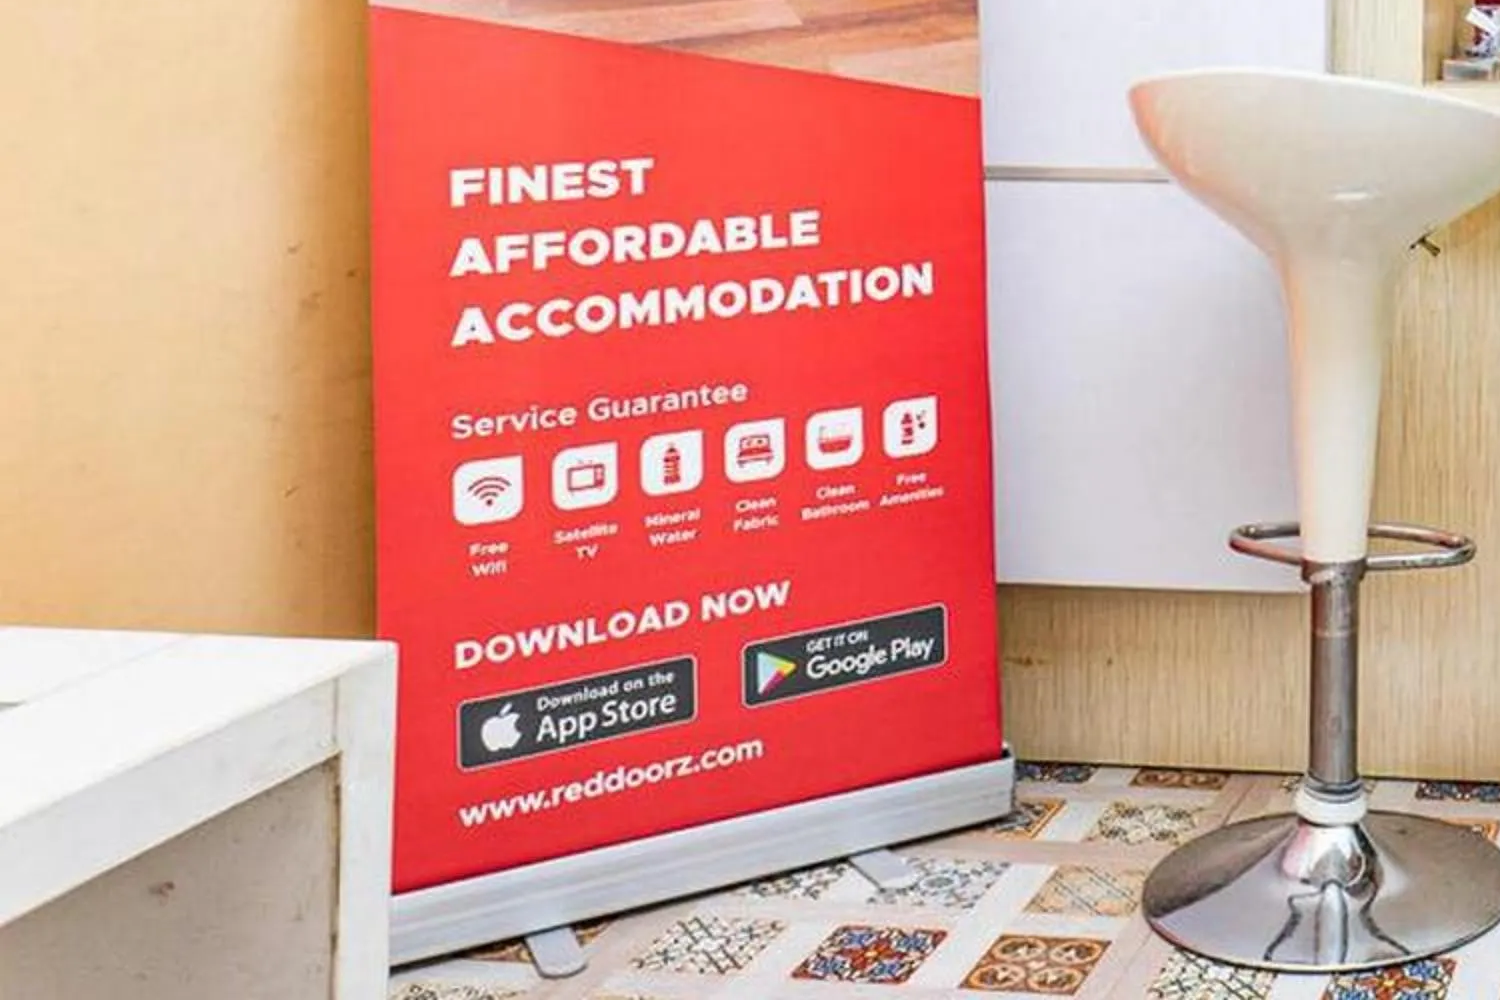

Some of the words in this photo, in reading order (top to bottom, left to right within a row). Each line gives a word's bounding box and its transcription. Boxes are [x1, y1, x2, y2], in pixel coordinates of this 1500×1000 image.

[449, 157, 655, 207] FINEST
[449, 210, 821, 277] AFFORDABLE
[450, 262, 935, 347] ACCOMMODATION
[452, 401, 577, 441] Service
[588, 382, 749, 423] Guarantee
[896, 472, 928, 487] Free
[815, 483, 857, 500] Clean
[879, 485, 945, 507] Amenities
[735, 496, 778, 513] Clean
[800, 499, 871, 521] Bathroom
[644, 507, 702, 528] Mineral
[733, 515, 780, 532] Fabric
[553, 522, 619, 544] Satellite
[648, 528, 698, 547] Water
[468, 541, 509, 557] Free
[575, 543, 600, 559] TV
[454, 600, 691, 670] DOWNLOAD
[700, 580, 792, 622] NOW
[806, 636, 832, 653] GET
[833, 632, 846, 647] IT
[847, 629, 869, 645] ON
[806, 643, 889, 679] Google
[890, 636, 935, 661] Play
[536, 680, 619, 711] Download
[623, 678, 644, 692] on
[648, 671, 674, 687] the
[536, 711, 598, 744] App
[601, 693, 677, 727] Store
[458, 738, 763, 828] www.reddoorz.com
